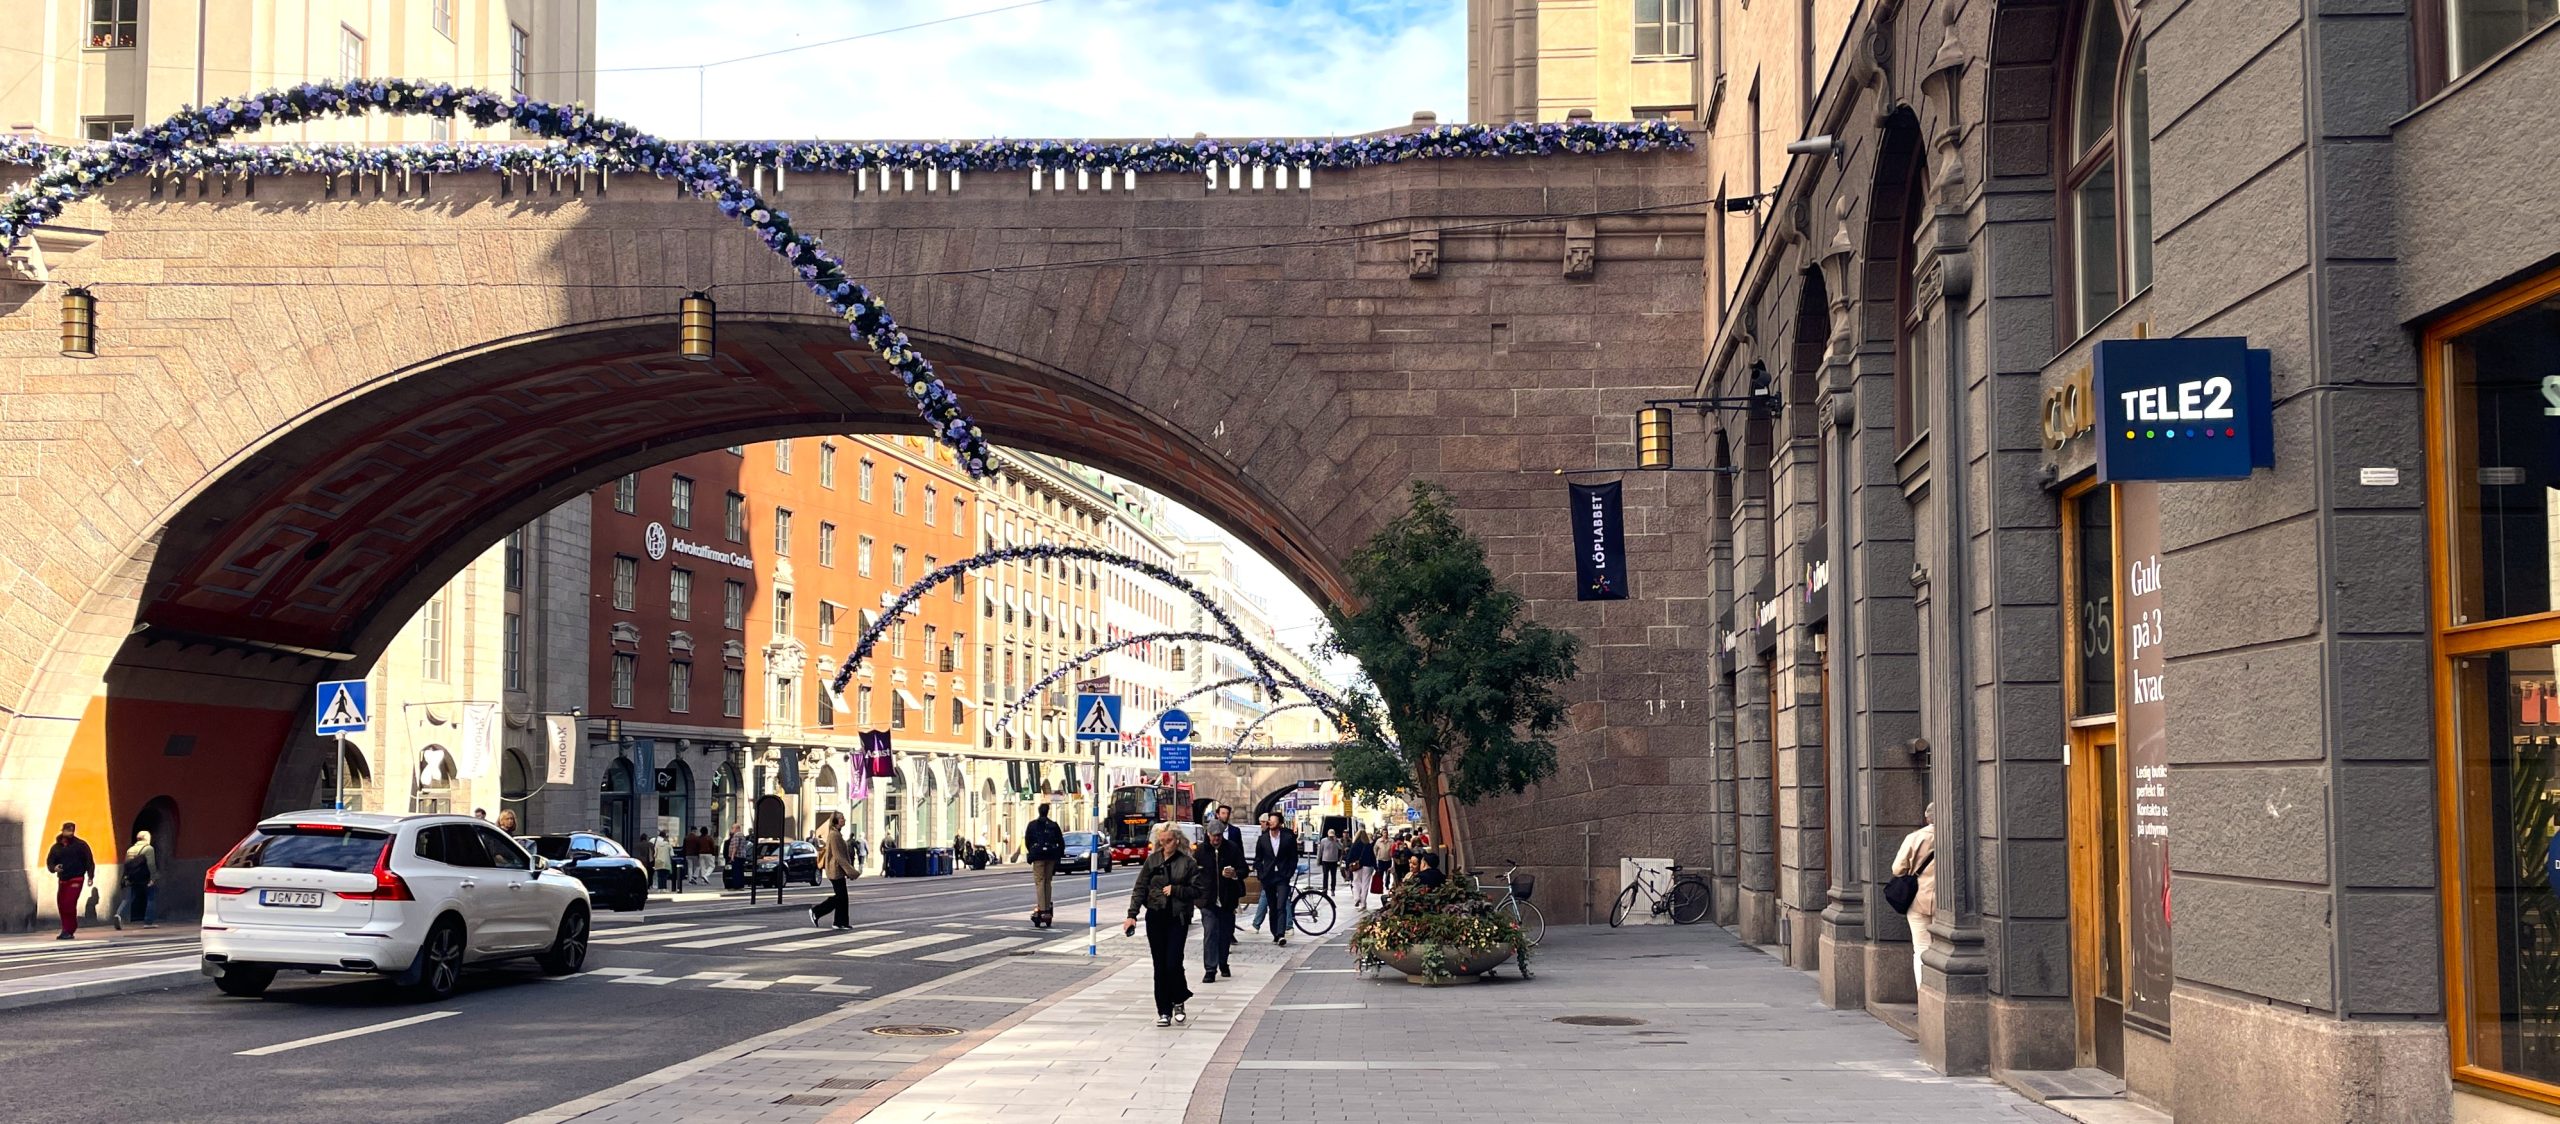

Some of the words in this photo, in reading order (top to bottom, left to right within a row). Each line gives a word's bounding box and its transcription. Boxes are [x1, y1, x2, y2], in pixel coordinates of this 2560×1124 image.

[2121, 376, 2234, 421] TELE2
[1592, 496, 1606, 569] LÖPLABBET
[672, 538, 730, 564] Advokatfirman
[2084, 596, 2111, 658] 35
[2132, 611, 2150, 660] på
[559, 736, 567, 779] HOUDINI
[2136, 766, 2151, 781] Ledig
[2136, 784, 2156, 800] perfekt
[2156, 784, 2165, 797] för
[2136, 803, 2161, 816] Kontakta
[2137, 820, 2145, 838] på
[270, 891, 291, 903] JGN
[295, 892, 317, 904] 705
